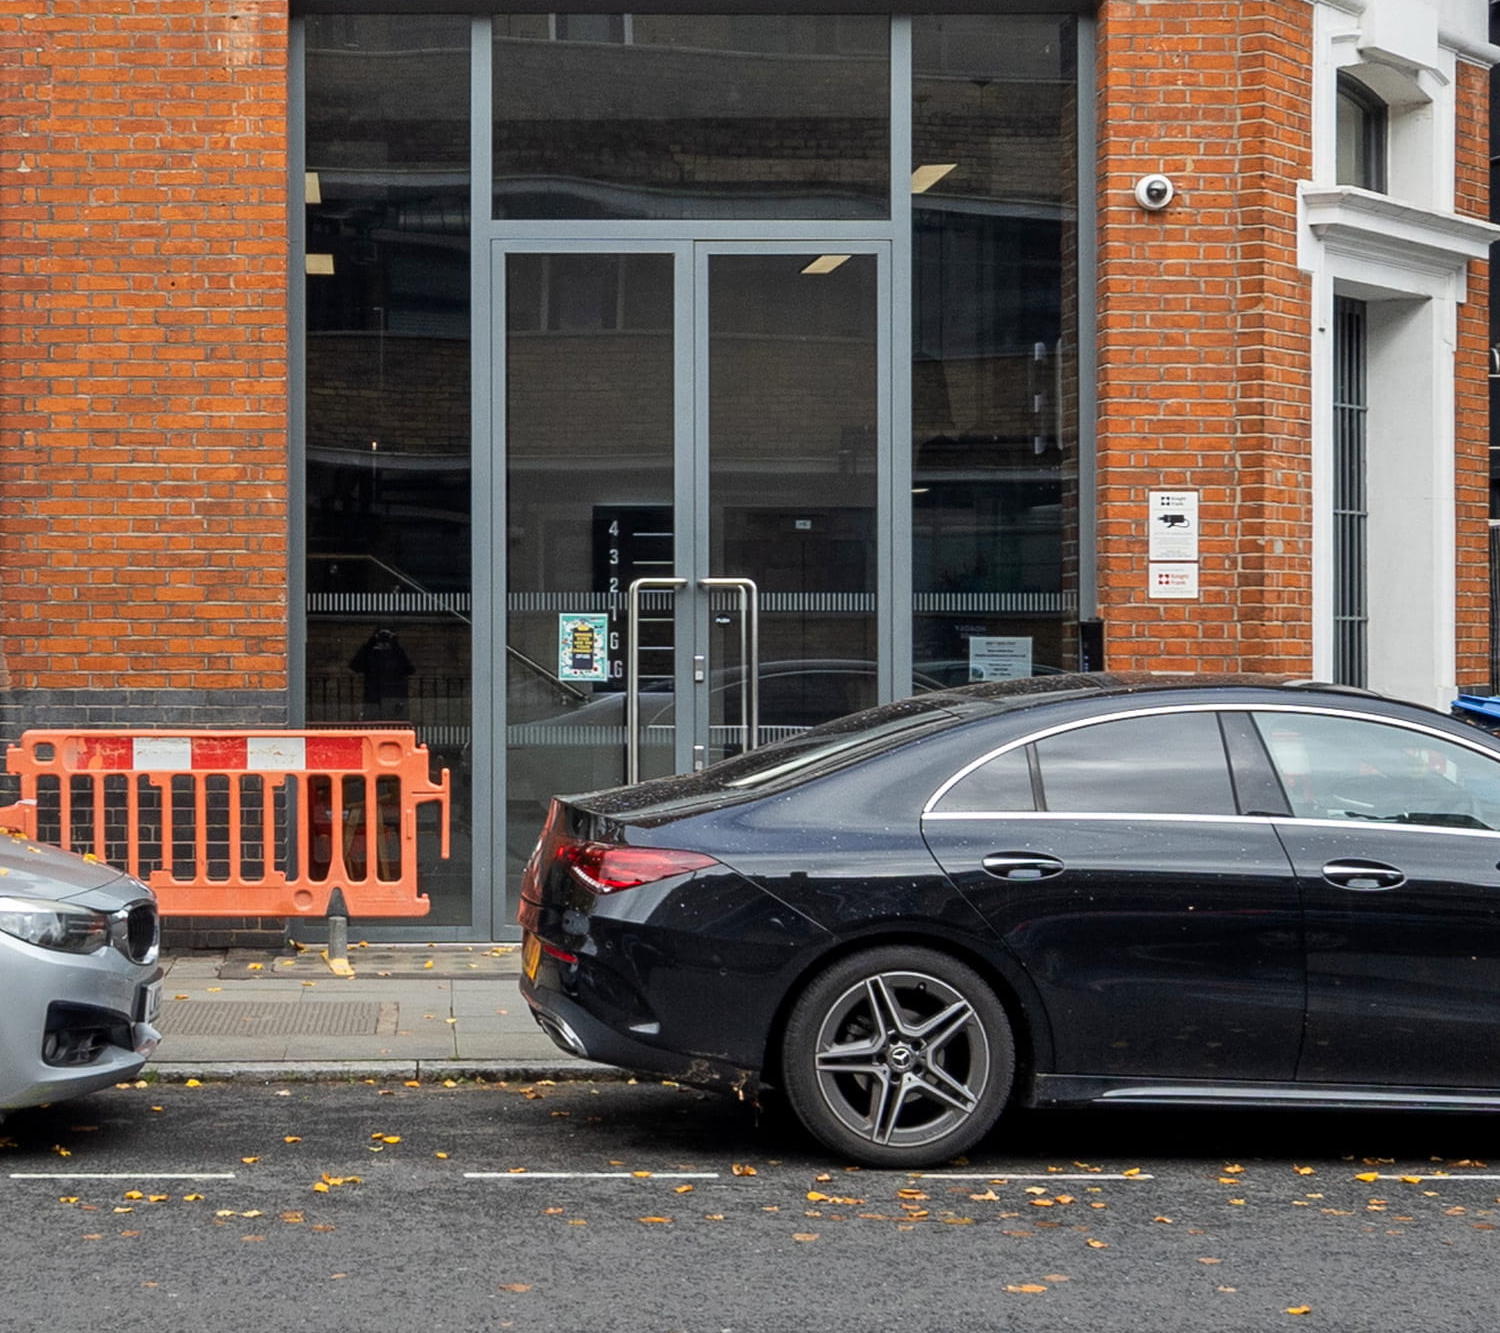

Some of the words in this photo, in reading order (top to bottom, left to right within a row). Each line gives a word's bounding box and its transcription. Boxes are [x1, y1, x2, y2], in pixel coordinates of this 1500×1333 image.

[608, 520, 619, 536] 4
[609, 549, 619, 564] 3
[609, 577, 619, 593] 2
[610, 632, 619, 650] G
[607, 660, 623, 678] LG
